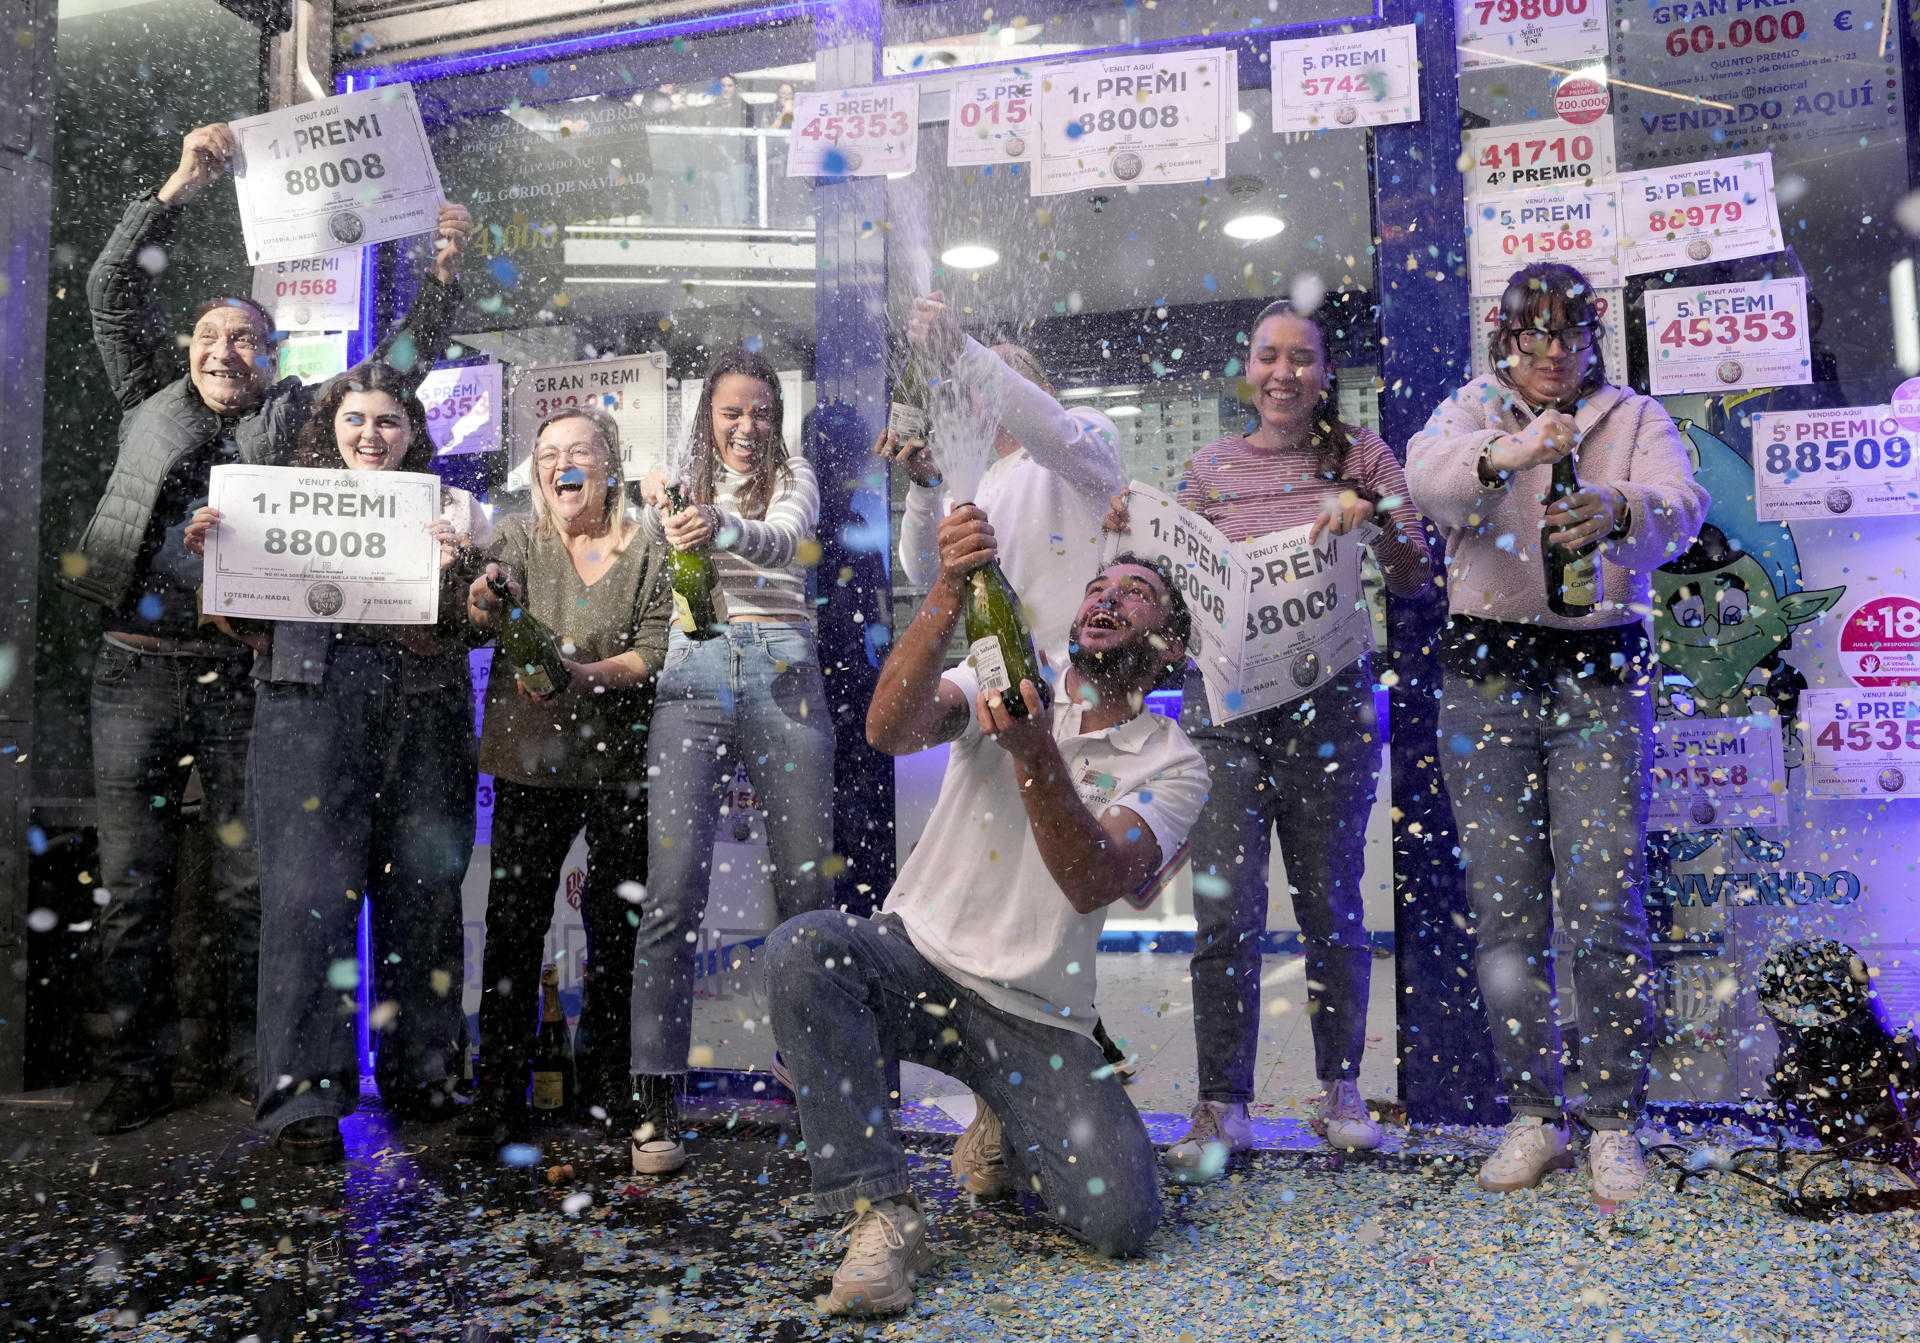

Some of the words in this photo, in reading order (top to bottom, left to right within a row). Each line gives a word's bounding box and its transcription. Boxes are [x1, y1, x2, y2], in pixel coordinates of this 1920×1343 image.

[1666, 10, 1805, 58] 60.000
[1833, 10, 1853, 31] €
[1104, 65, 1131, 73] VENUT
[1322, 48, 1386, 69] PREMI
[1710, 55, 1753, 70] QUINTO
[1756, 50, 1800, 65] PREMIO
[1658, 77, 1692, 88] Semana
[1710, 70, 1743, 81] Viernes
[1758, 66, 1770, 74] de
[1772, 58, 1818, 72] Diciembre
[1820, 56, 1832, 64] de
[1068, 86, 1090, 103] 1r
[1097, 72, 1186, 98] PREMI
[1758, 80, 1808, 96] Nacional
[295, 110, 318, 123] VENUT
[836, 97, 894, 115] PREMI
[1640, 101, 1782, 135] VENDIDO
[1792, 80, 1874, 116] AQUÍ
[801, 112, 910, 142] 45353
[1078, 106, 1179, 134] 88008
[294, 114, 382, 154] PREMI
[1480, 136, 1594, 170] 41710
[284, 153, 386, 196] 88008
[1512, 163, 1592, 184] PREMIO
[1670, 172, 1692, 180] VENUT
[478, 191, 494, 202] EL
[498, 184, 551, 202] GORDO
[556, 182, 575, 192] DE
[579, 173, 646, 190] NAVIDAD
[1666, 176, 1738, 200] PREMI
[1520, 204, 1590, 224] PREMI
[1502, 229, 1593, 255] 01568
[291, 258, 339, 272] PREMI
[276, 279, 337, 296] 01568
[1700, 294, 1774, 316] PREMI
[1660, 311, 1796, 348] 45353
[433, 383, 478, 399] PREMI
[535, 374, 584, 393] GRAN
[590, 368, 640, 388] PREMI
[1808, 410, 1841, 418] VENDIDO
[1796, 418, 1898, 440] PREMIO
[1766, 436, 1911, 474] 88509
[298, 479, 330, 488] VENUT
[252, 493, 282, 514] 1r
[290, 491, 396, 518] PREMI
[264, 528, 387, 558] 88008
[1150, 518, 1169, 542] 1r
[1174, 524, 1231, 590] PREMI
[1246, 546, 1279, 560] VENUT
[1250, 540, 1338, 594] PREMI
[224, 592, 255, 600] LOTERIA
[1157, 554, 1224, 624] 88008
[374, 598, 412, 606] DESEMBRE
[1862, 606, 1920, 638] +18
[1673, 738, 1746, 758] PREMI
[1816, 720, 1920, 752] 4535
